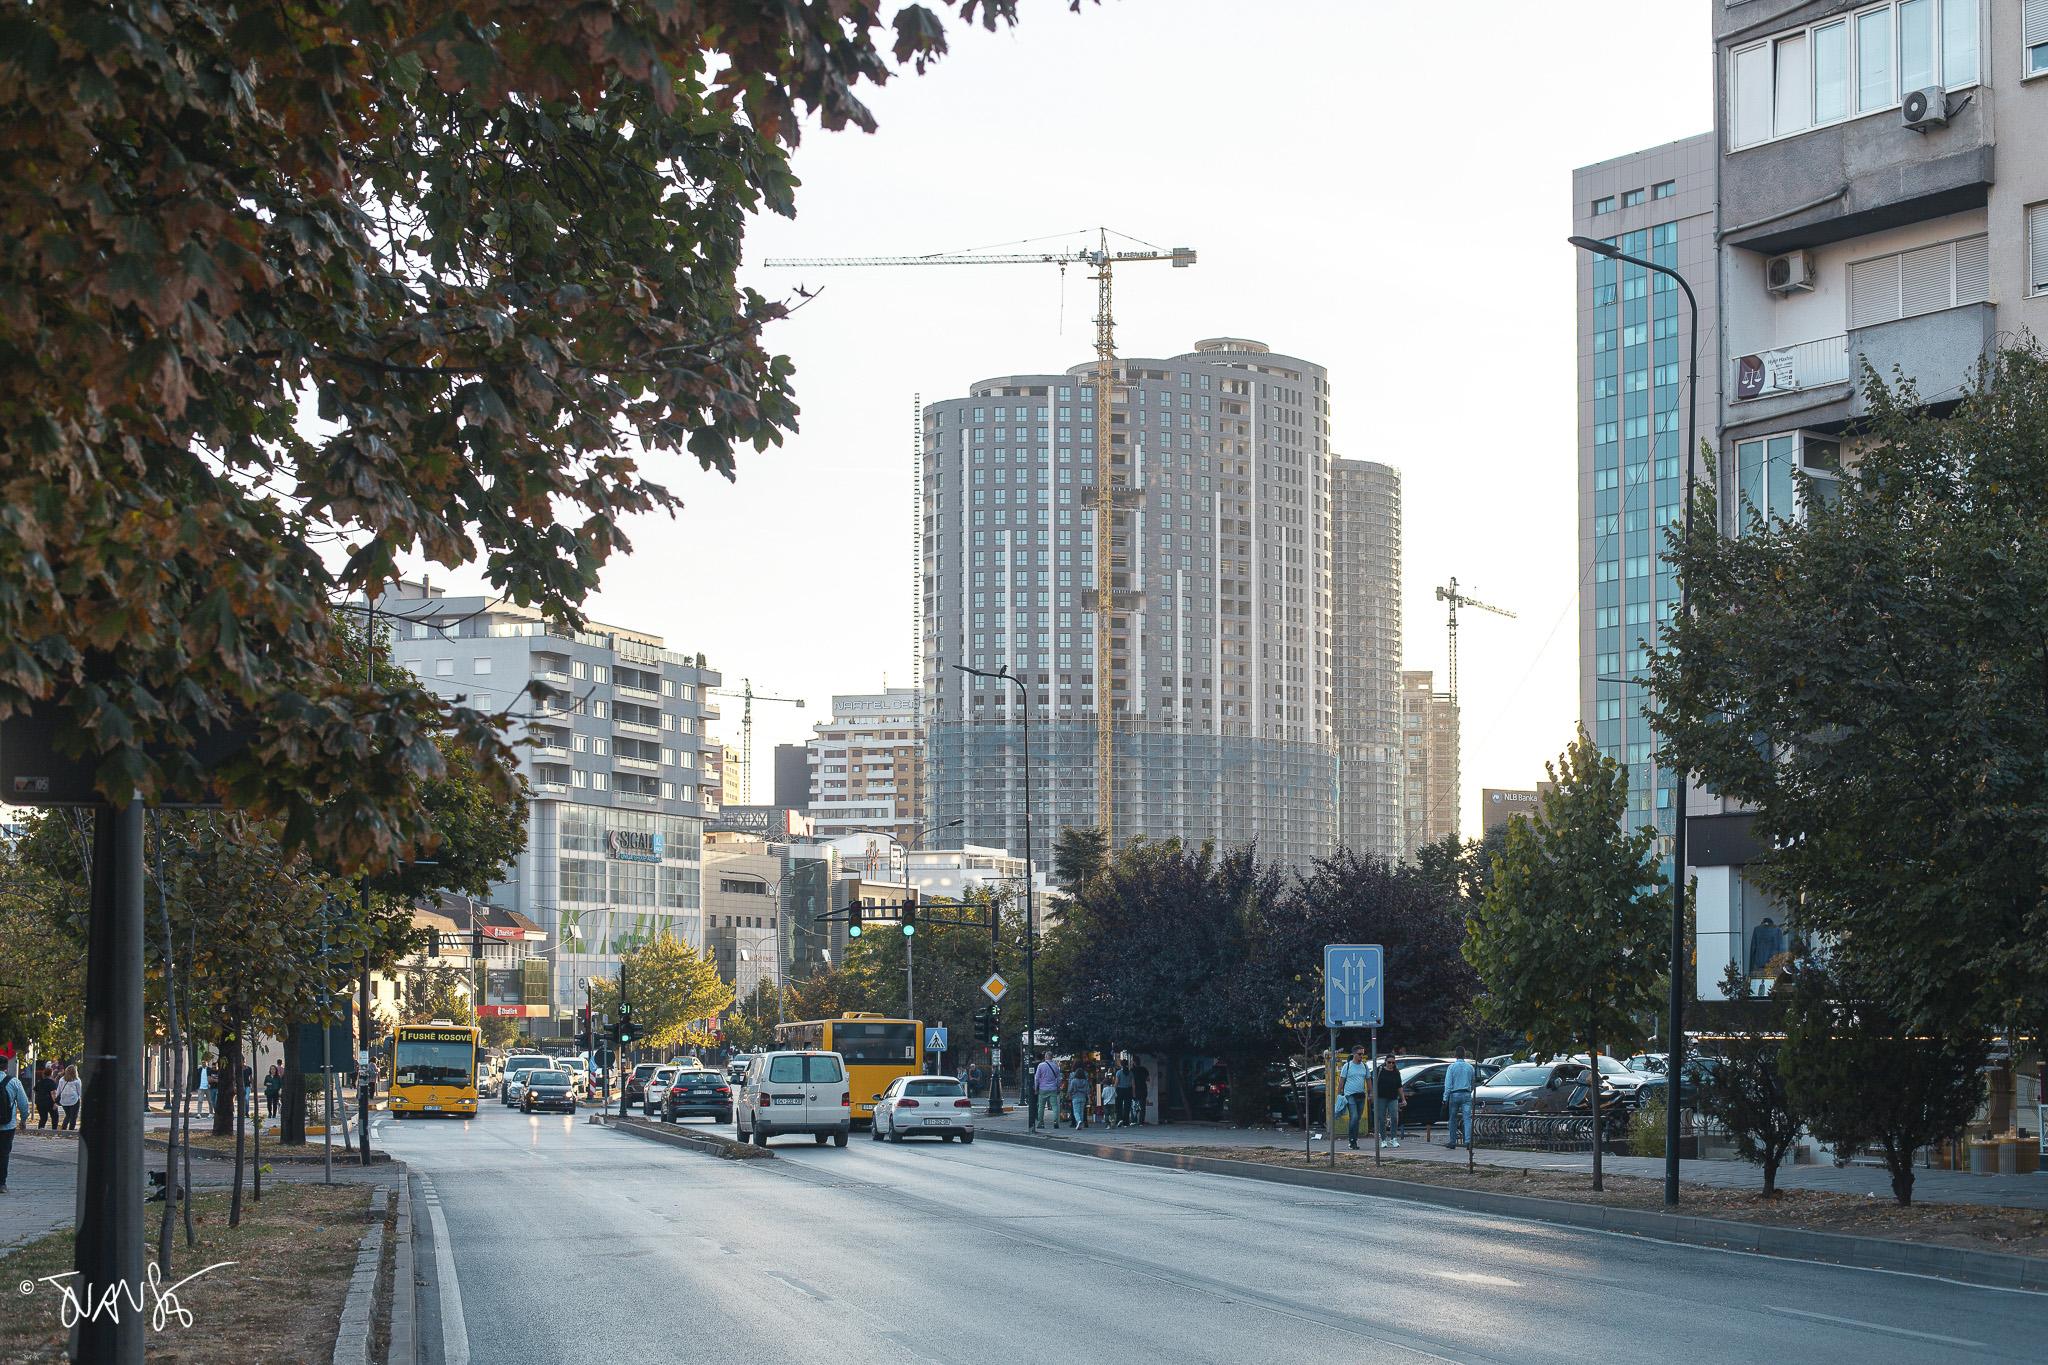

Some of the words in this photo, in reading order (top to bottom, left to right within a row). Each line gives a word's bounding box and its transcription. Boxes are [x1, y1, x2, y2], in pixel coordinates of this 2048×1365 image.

[834, 700, 890, 710] NARTEL
[1504, 793, 1517, 801] NLB
[1518, 793, 1538, 802] Banka
[620, 830, 654, 849] SIGAL
[401, 1030, 407, 1041] 1
